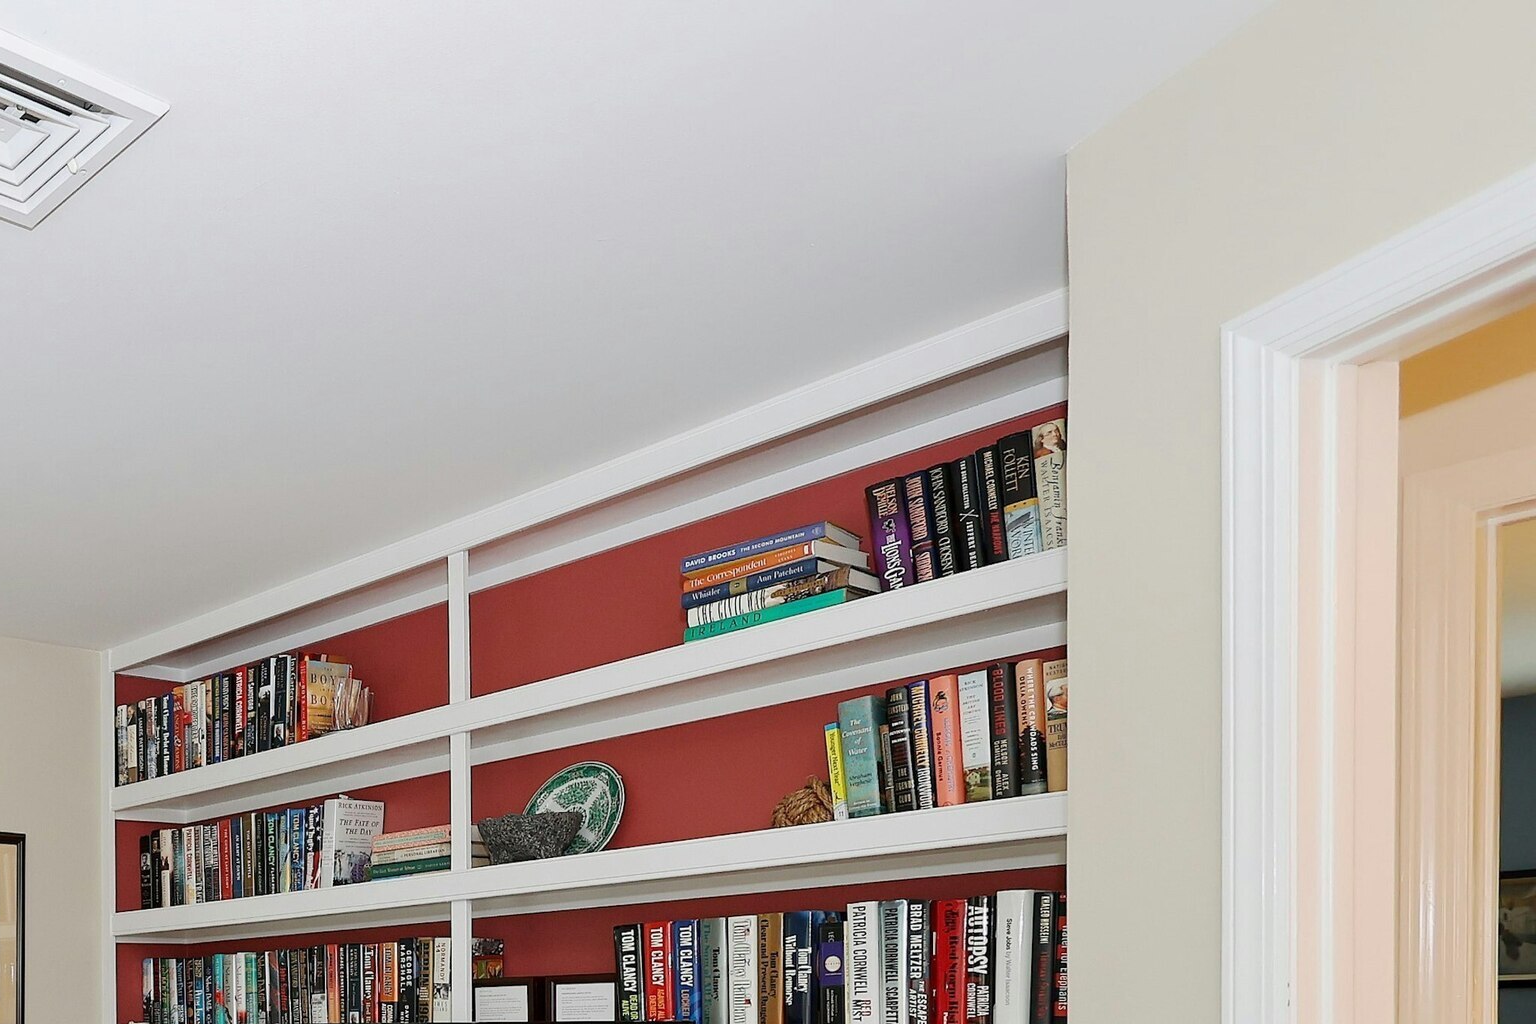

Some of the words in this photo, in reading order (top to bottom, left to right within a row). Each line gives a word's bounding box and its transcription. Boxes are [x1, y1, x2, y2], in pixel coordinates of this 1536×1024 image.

[929, 467, 944, 489] JOHN
[983, 451, 994, 480] MICHAEL
[1003, 448, 1019, 492] FOLLETT
[1016, 455, 1030, 479] KEN
[905, 476, 924, 500] JOHN
[1040, 460, 1051, 503] WALTER
[884, 483, 898, 516] NELSON
[985, 480, 998, 511] CONNELLY
[907, 496, 928, 541] SANDFORD
[933, 489, 950, 534] SANDFORD
[741, 545, 751, 553] THE
[751, 539, 774, 550] SECOND
[775, 532, 805, 543] MOUNTAIN
[685, 556, 706, 568] DAVID
[708, 549, 736, 562] BROOKS
[689, 579, 704, 588] The
[706, 558, 767, 584] Correspondent
[756, 574, 772, 584] Ann
[774, 565, 804, 579] Patchett
[691, 587, 721, 601] Whistler
[690, 613, 762, 638] IRELAND
[235, 671, 243, 700] PATRICIA
[289, 671, 297, 700] Garten
[992, 668, 1004, 701] BLOOD
[1026, 667, 1034, 694] WHERE
[247, 682, 255, 710] SANDFORD
[911, 685, 927, 727] MICHAEL
[1027, 694, 1035, 709] THE
[235, 700, 243, 734] CORNWELL
[850, 718, 862, 727] The
[994, 704, 1006, 735] LINES
[1028, 709, 1038, 752] CRAWDADS
[842, 726, 872, 739] Covenant
[854, 736, 862, 745] of
[848, 746, 868, 756] Water
[914, 727, 930, 768] CONNELLY
[1001, 739, 1009, 765] NELSON
[1030, 752, 1039, 770] SING
[1002, 773, 1010, 790] ALEX
[354, 803, 383, 811] ATKINSON
[292, 813, 300, 831] TOM
[355, 819, 370, 827] FATE
[236, 834, 240, 842] AN
[292, 832, 300, 863] CLANCY
[909, 904, 923, 930] BRAD
[1039, 895, 1051, 918] KHALED
[650, 927, 663, 948] TOM
[679, 925, 692, 947] TOM
[733, 919, 752, 942] Tom
[760, 919, 769, 942] Clear
[853, 906, 867, 946] PATRICIA
[885, 908, 899, 941] PATRICIA
[1005, 918, 1013, 935] Steve
[1038, 918, 1051, 944] HOSSEINI
[621, 929, 635, 952] TOM
[761, 942, 769, 959] and
[785, 934, 797, 968] Without
[967, 902, 989, 975] AUTOPSY
[1005, 936, 1013, 950] Jobs
[364, 946, 375, 969] Tom
[384, 947, 392, 963] TOM
[651, 950, 665, 986] CLANCY
[679, 949, 694, 987] CLANCY
[712, 947, 721, 967] Tom
[732, 942, 752, 977] Clancy
[770, 951, 778, 968] Tom
[797, 946, 812, 964] Tom
[885, 943, 899, 984] CORNWELL
[909, 935, 923, 979] MELTZER
[205, 975, 213, 993] Nelson
[363, 970, 375, 1000] Clancy
[384, 966, 393, 997] CLANCY
[622, 953, 638, 992] CLANCY
[711, 968, 721, 1001] Clancy
[760, 960, 769, 994] Present
[768, 969, 778, 998] Clancy
[793, 964, 812, 993] Clancy
[853, 949, 868, 996] CORNWELL
[785, 968, 797, 1006] Remorse
[966, 982, 977, 1019] CORNWELL
[976, 985, 990, 1016] PATRICIA
[1058, 967, 1068, 1010] Elephants
[621, 1000, 630, 1017] ALIVE
[629, 994, 638, 1012] DEAD
[681, 990, 691, 1016] LOCKED
[733, 979, 753, 1023] Rainbow
[852, 999, 863, 1022] MIST
[862, 999, 871, 1017] RED
[908, 989, 918, 1018] ARTIST
[917, 993, 928, 1024] ESCAPE
